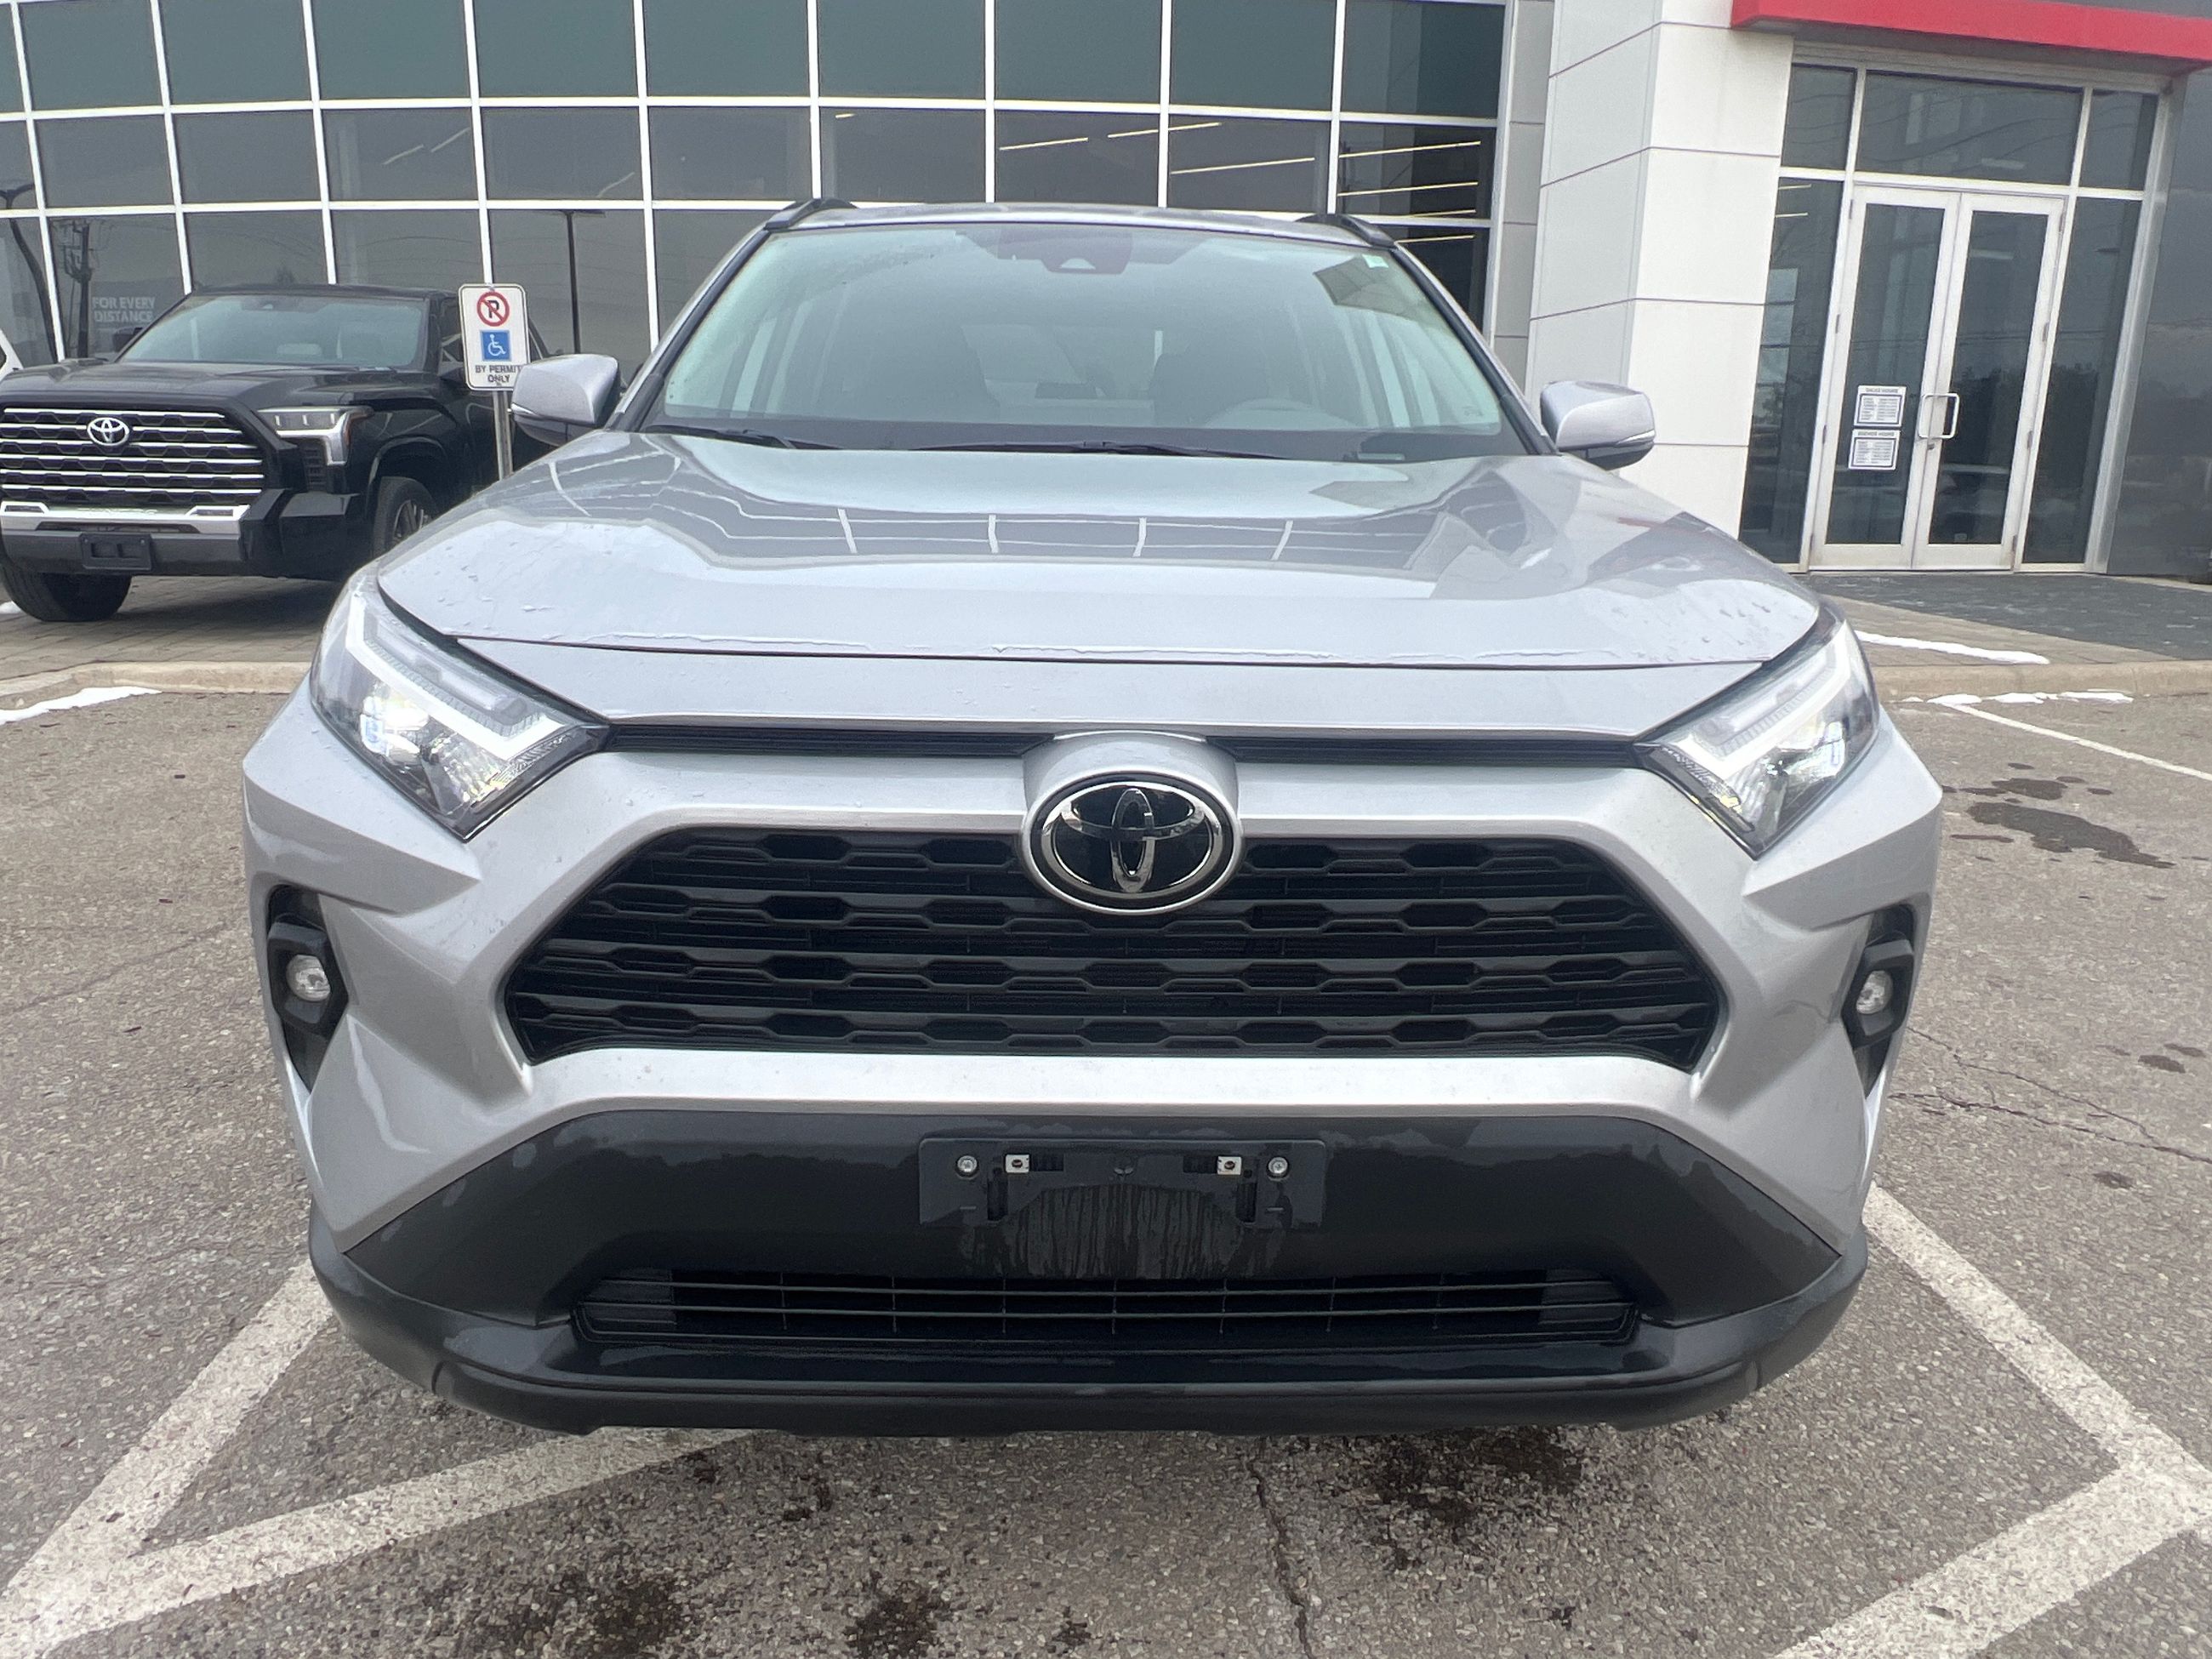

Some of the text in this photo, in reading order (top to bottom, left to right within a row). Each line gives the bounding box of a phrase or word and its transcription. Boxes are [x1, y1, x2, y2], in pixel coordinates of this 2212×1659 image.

[92, 297, 155, 309] FOR EVERY
[94, 311, 152, 322] DISTANCE
[475, 364, 486, 373] BY
[487, 374, 510, 383] ONLY
